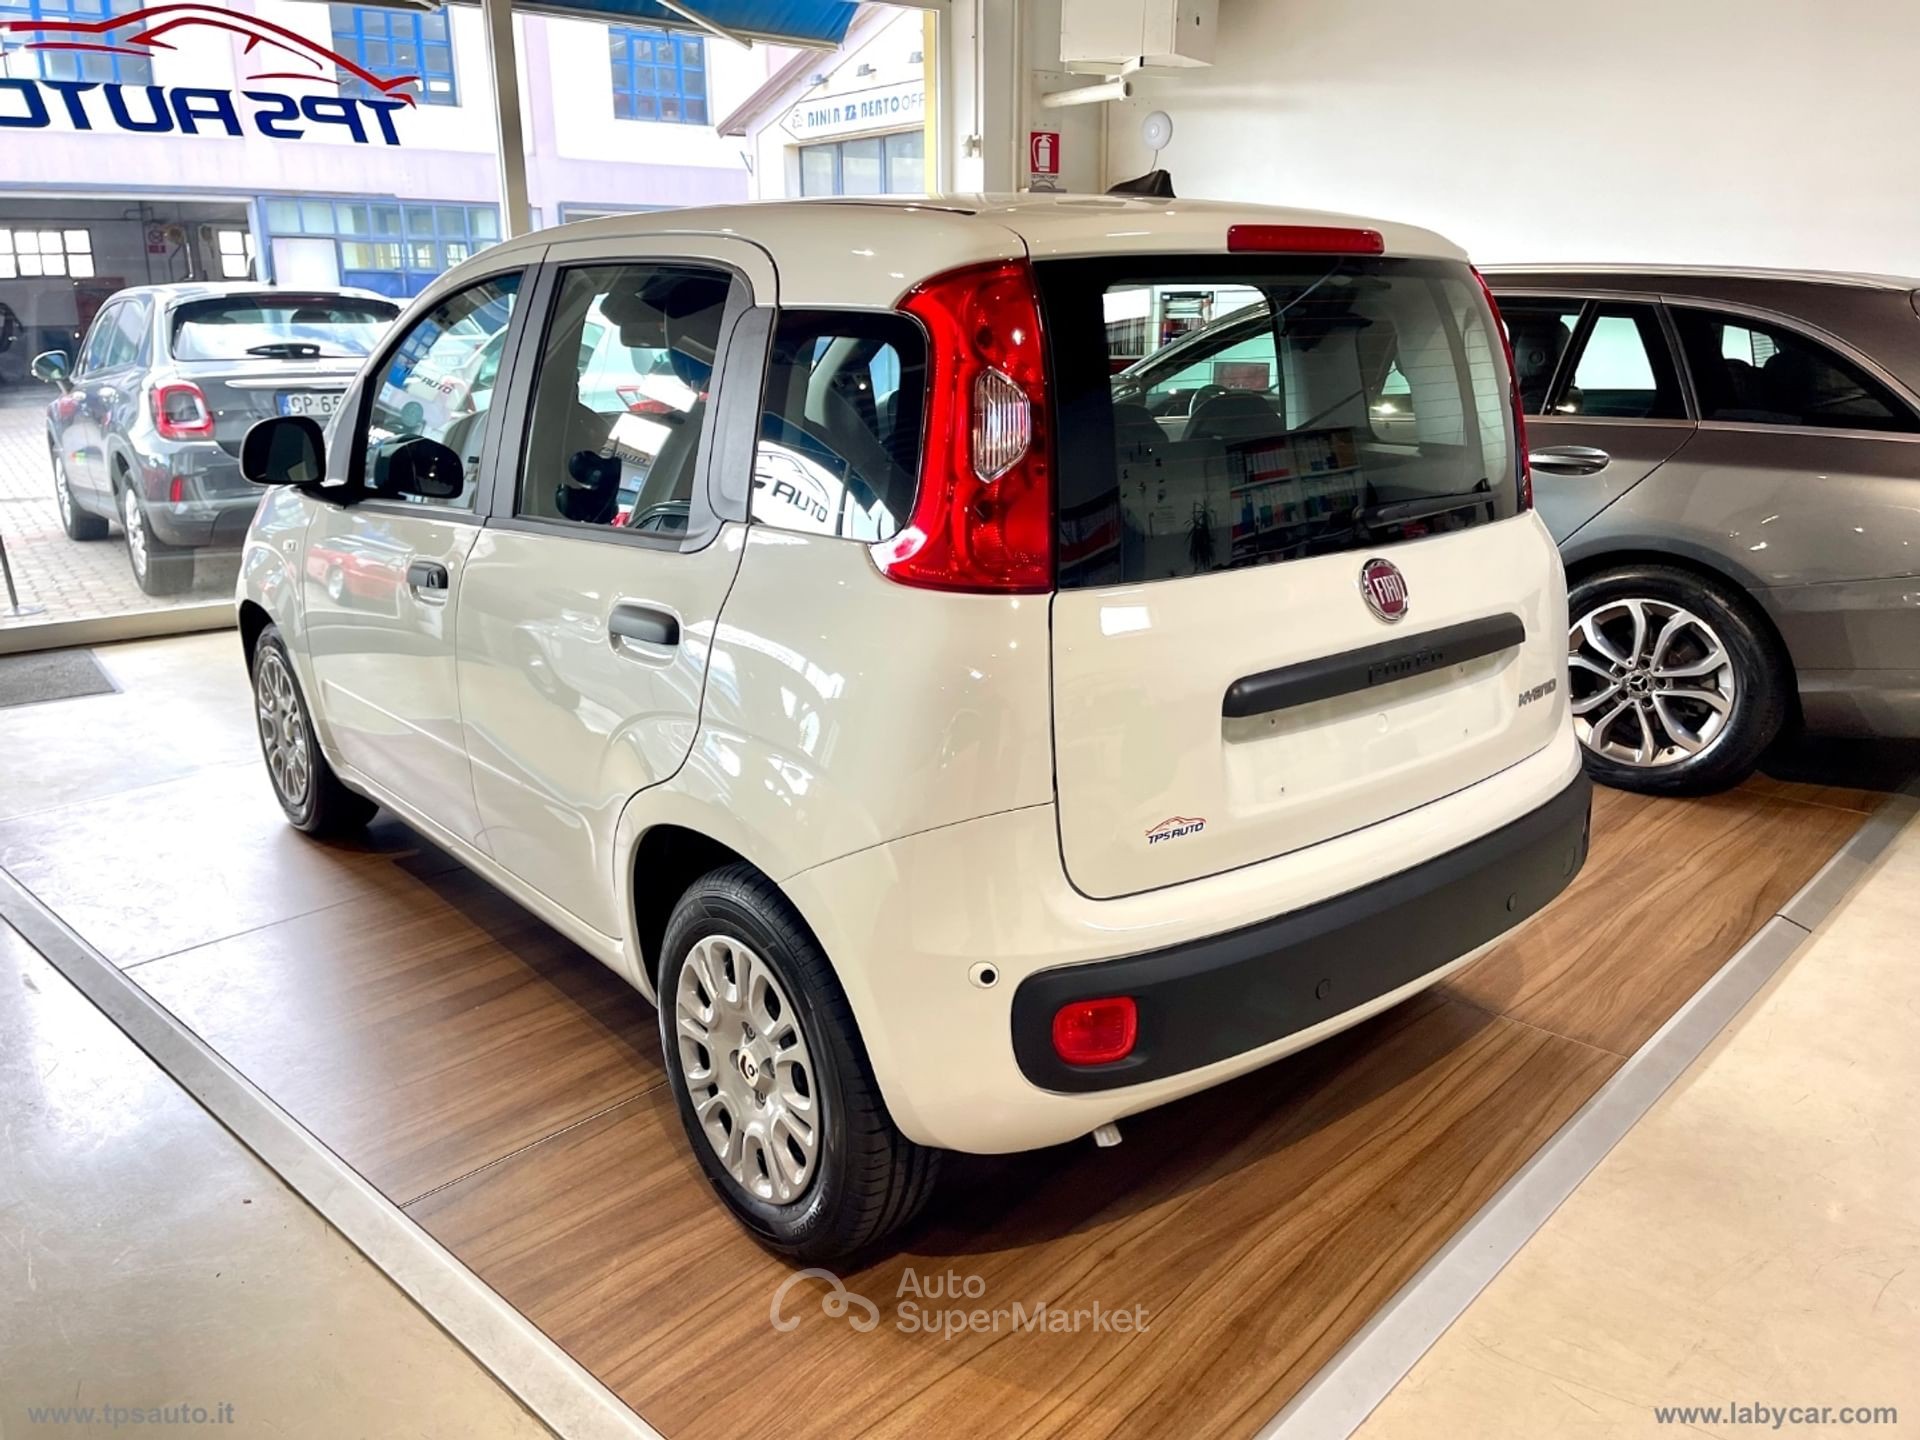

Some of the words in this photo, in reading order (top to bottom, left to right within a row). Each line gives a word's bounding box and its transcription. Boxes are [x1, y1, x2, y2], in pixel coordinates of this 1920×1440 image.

[772, 479, 828, 523] AUTO
[1373, 574, 1405, 605] FIAT
[1147, 830, 1171, 845] TPS
[1171, 822, 1204, 838] AUTO
